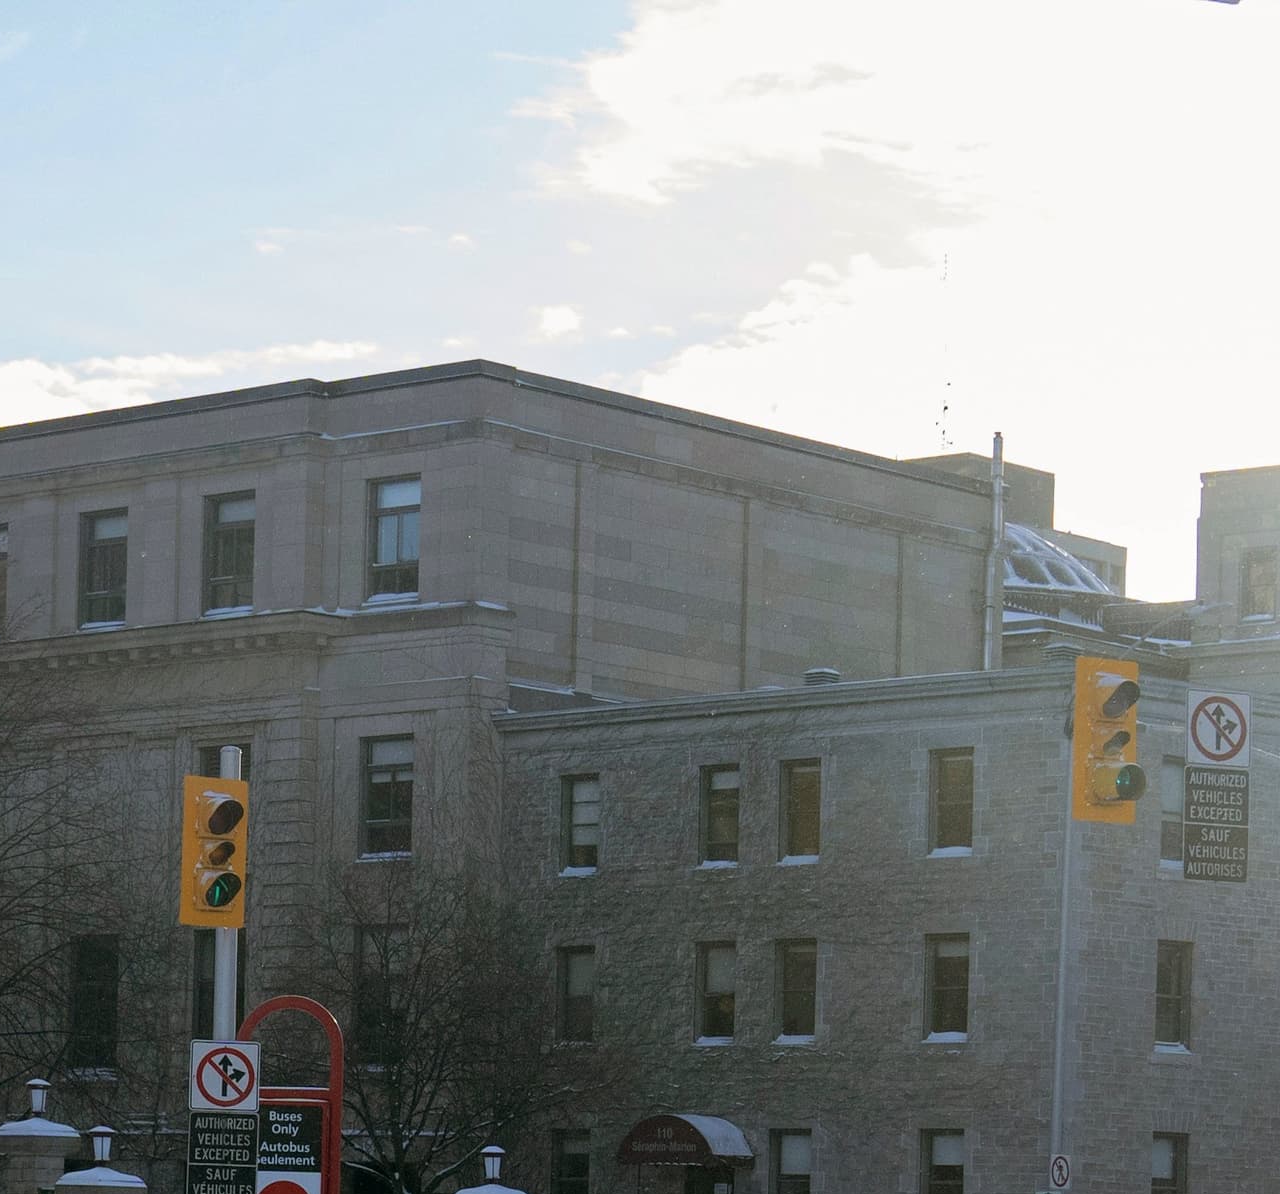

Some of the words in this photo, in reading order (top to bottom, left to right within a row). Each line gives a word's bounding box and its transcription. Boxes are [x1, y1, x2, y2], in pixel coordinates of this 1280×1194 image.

[1189, 772, 1247, 788] AUTHORIZED
[1192, 790, 1243, 805] VEHICLES
[1190, 805, 1242, 822] EXCEPTED
[1201, 828, 1231, 842] SAUF
[1188, 842, 1246, 860] VÉHICULES
[269, 1111, 303, 1121] Buses
[195, 1117, 255, 1130] AUTHORIZED
[271, 1123, 299, 1137] Only
[656, 1127, 673, 1138] 110
[197, 1133, 251, 1146] VEHICLES
[260, 1141, 310, 1153] Autobus
[194, 1148, 250, 1161] EXCEPTED
[206, 1168, 237, 1181] SAUF
